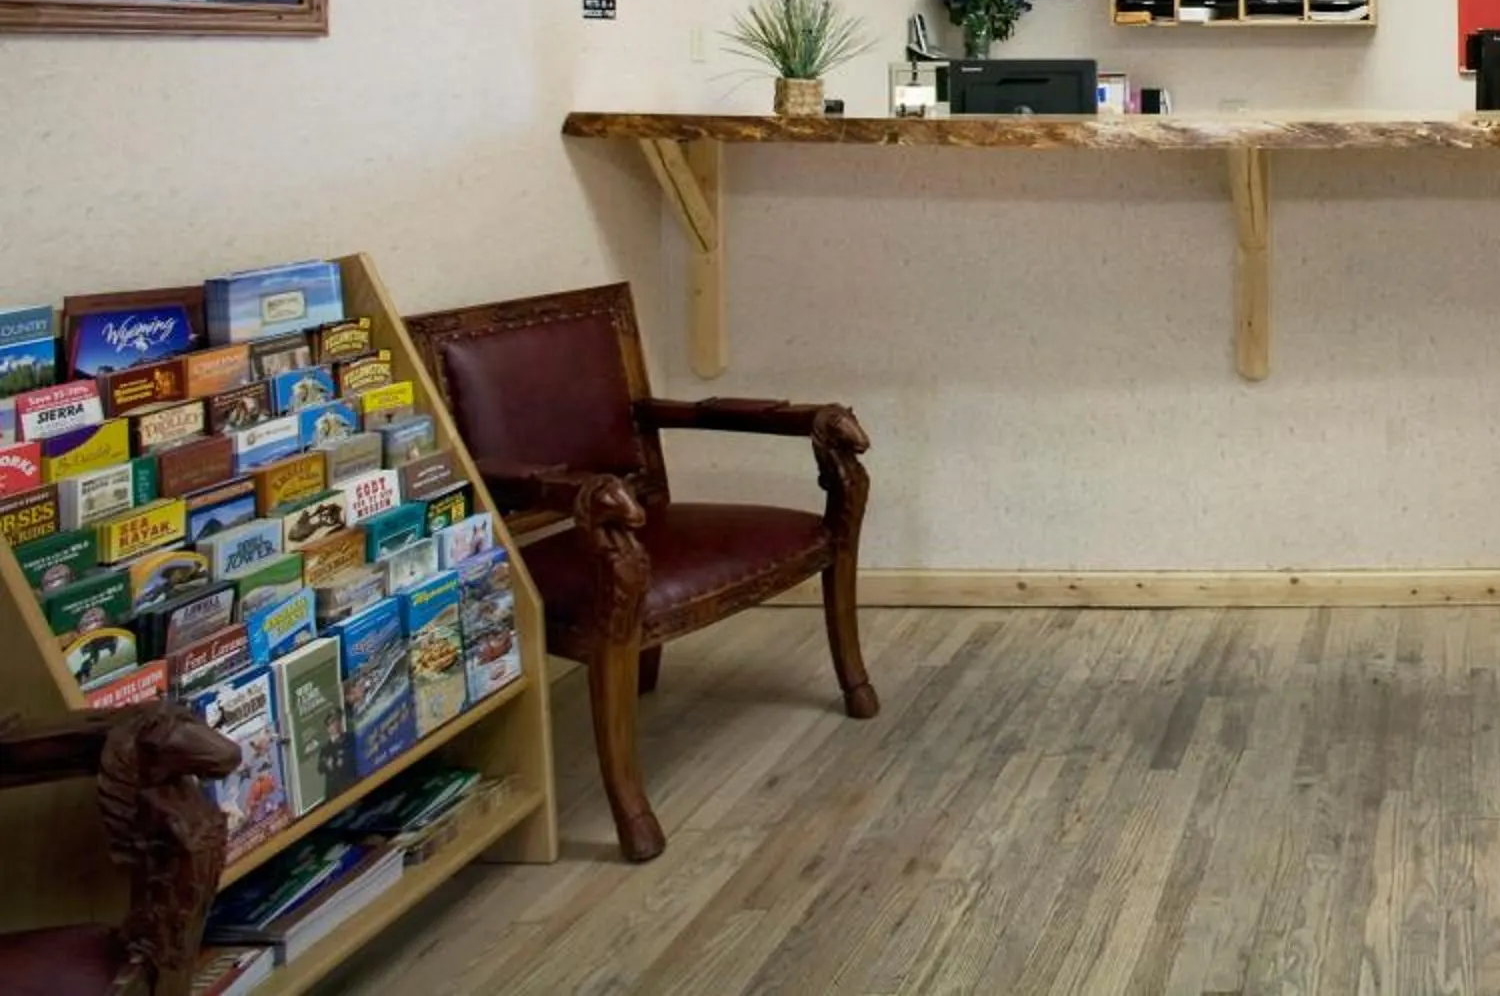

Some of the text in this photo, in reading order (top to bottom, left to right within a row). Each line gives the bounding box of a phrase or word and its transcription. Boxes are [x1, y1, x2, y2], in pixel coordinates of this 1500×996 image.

[101, 315, 178, 353] Wyoming
[37, 403, 85, 425] SIERRA
[356, 477, 385, 499] CODY
[0, 502, 55, 532] RSES
